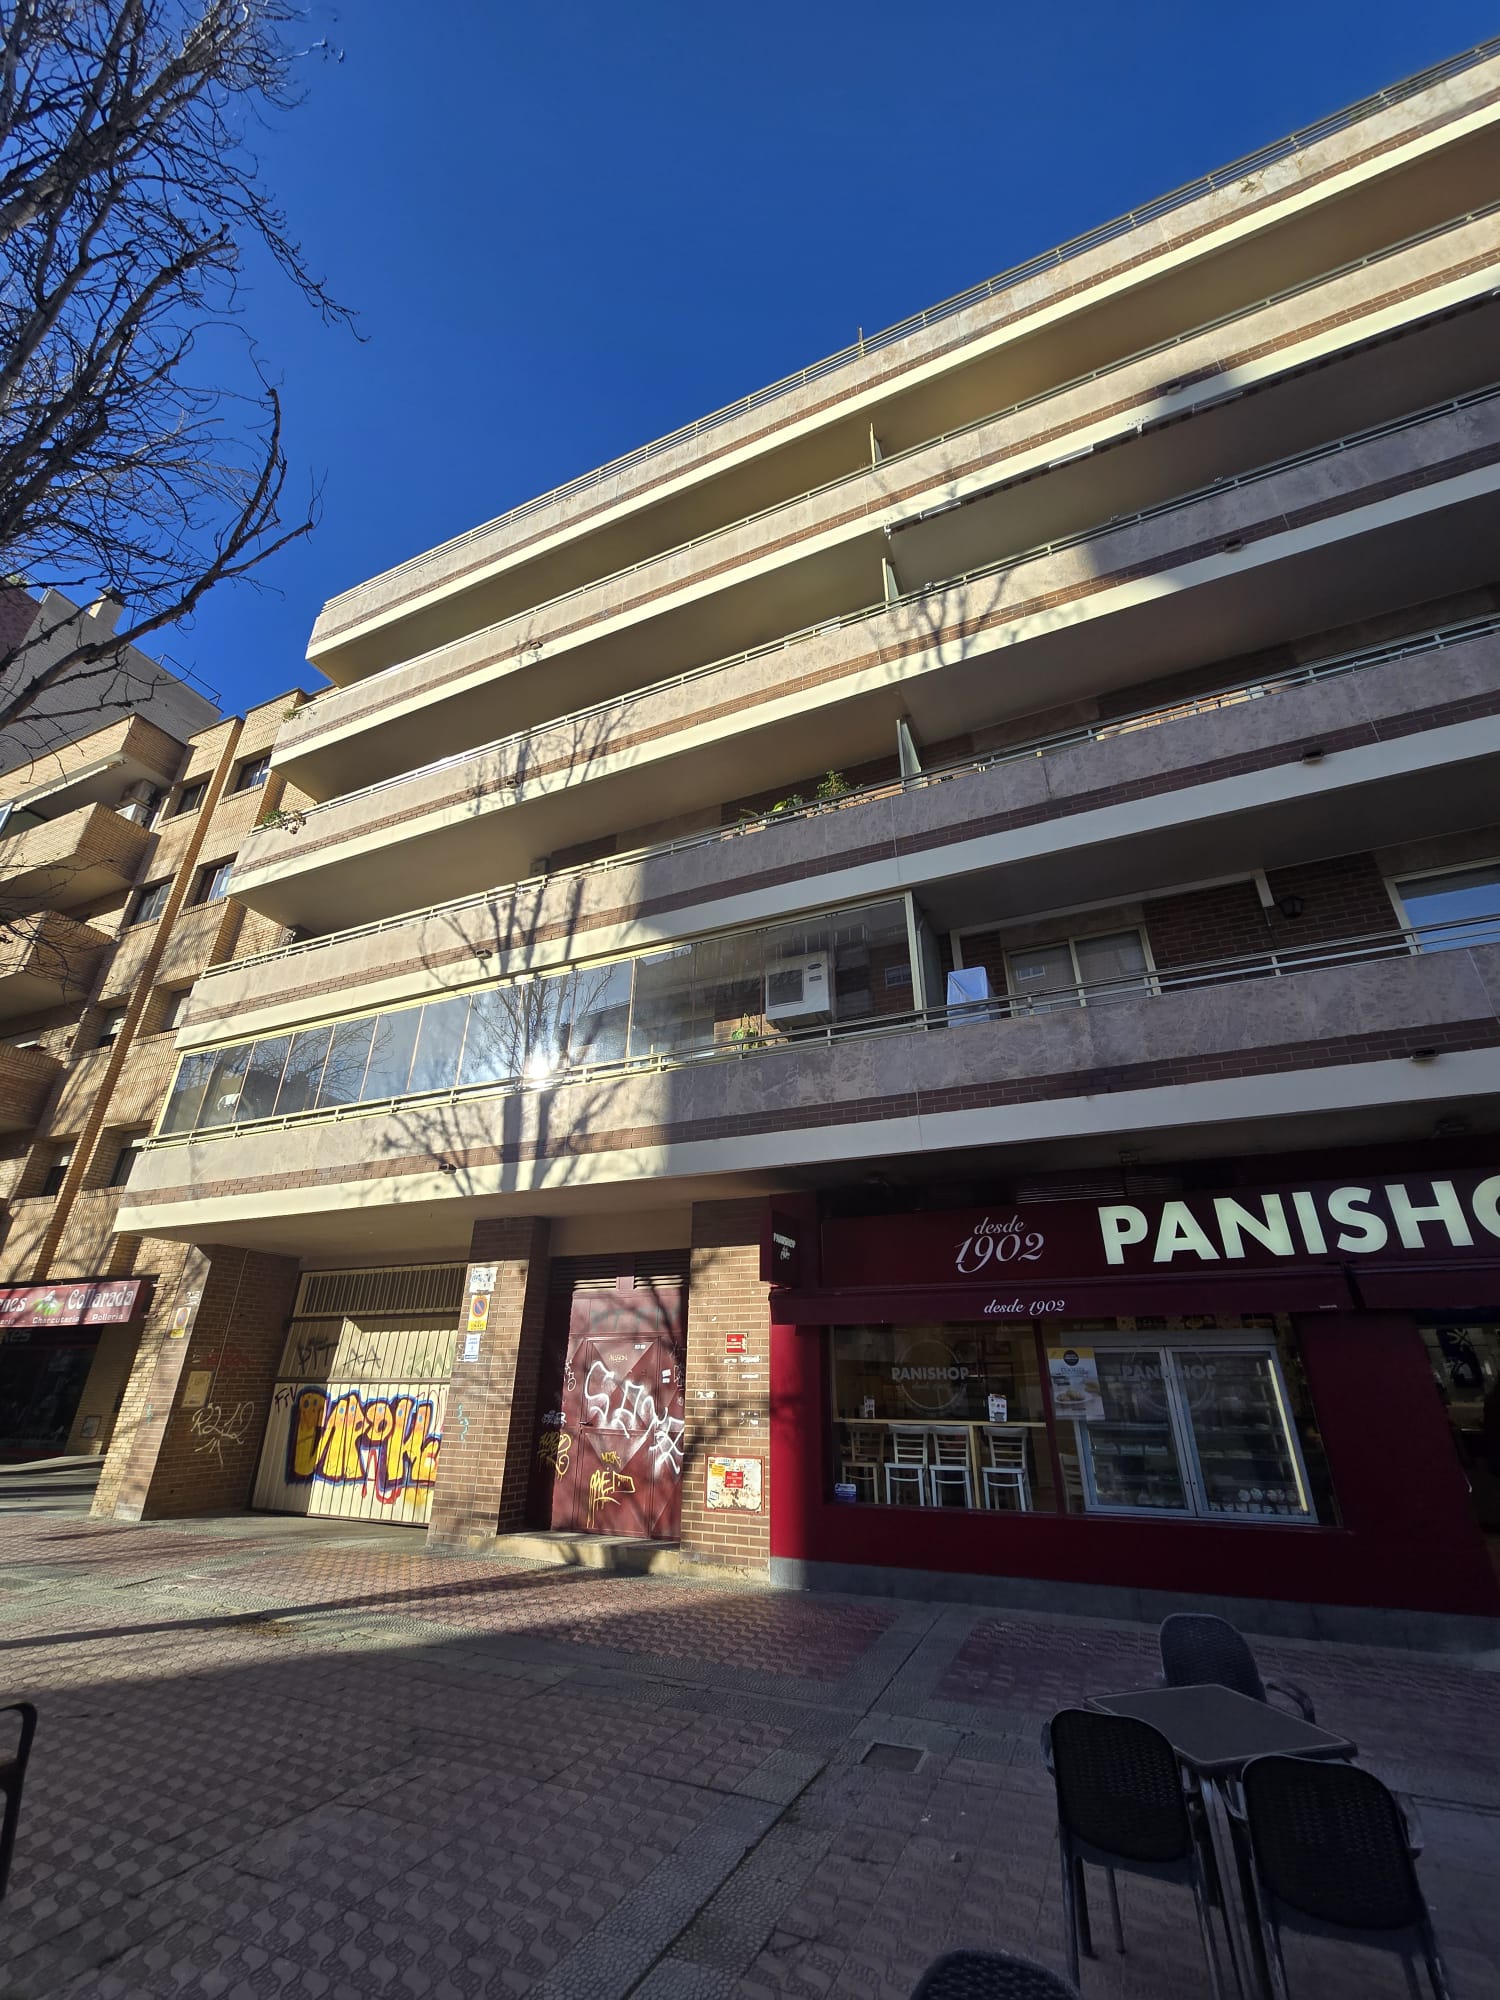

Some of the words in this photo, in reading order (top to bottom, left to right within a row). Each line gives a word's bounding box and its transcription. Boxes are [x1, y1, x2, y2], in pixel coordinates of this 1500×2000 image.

[974, 1215, 1024, 1235] desde
[954, 1232, 1045, 1273] 1902
[67, 1286, 134, 1310] Collarada
[984, 1299, 1024, 1313] desde
[1029, 1300, 1065, 1316] 1902
[891, 1366, 969, 1382] PANISHOP
